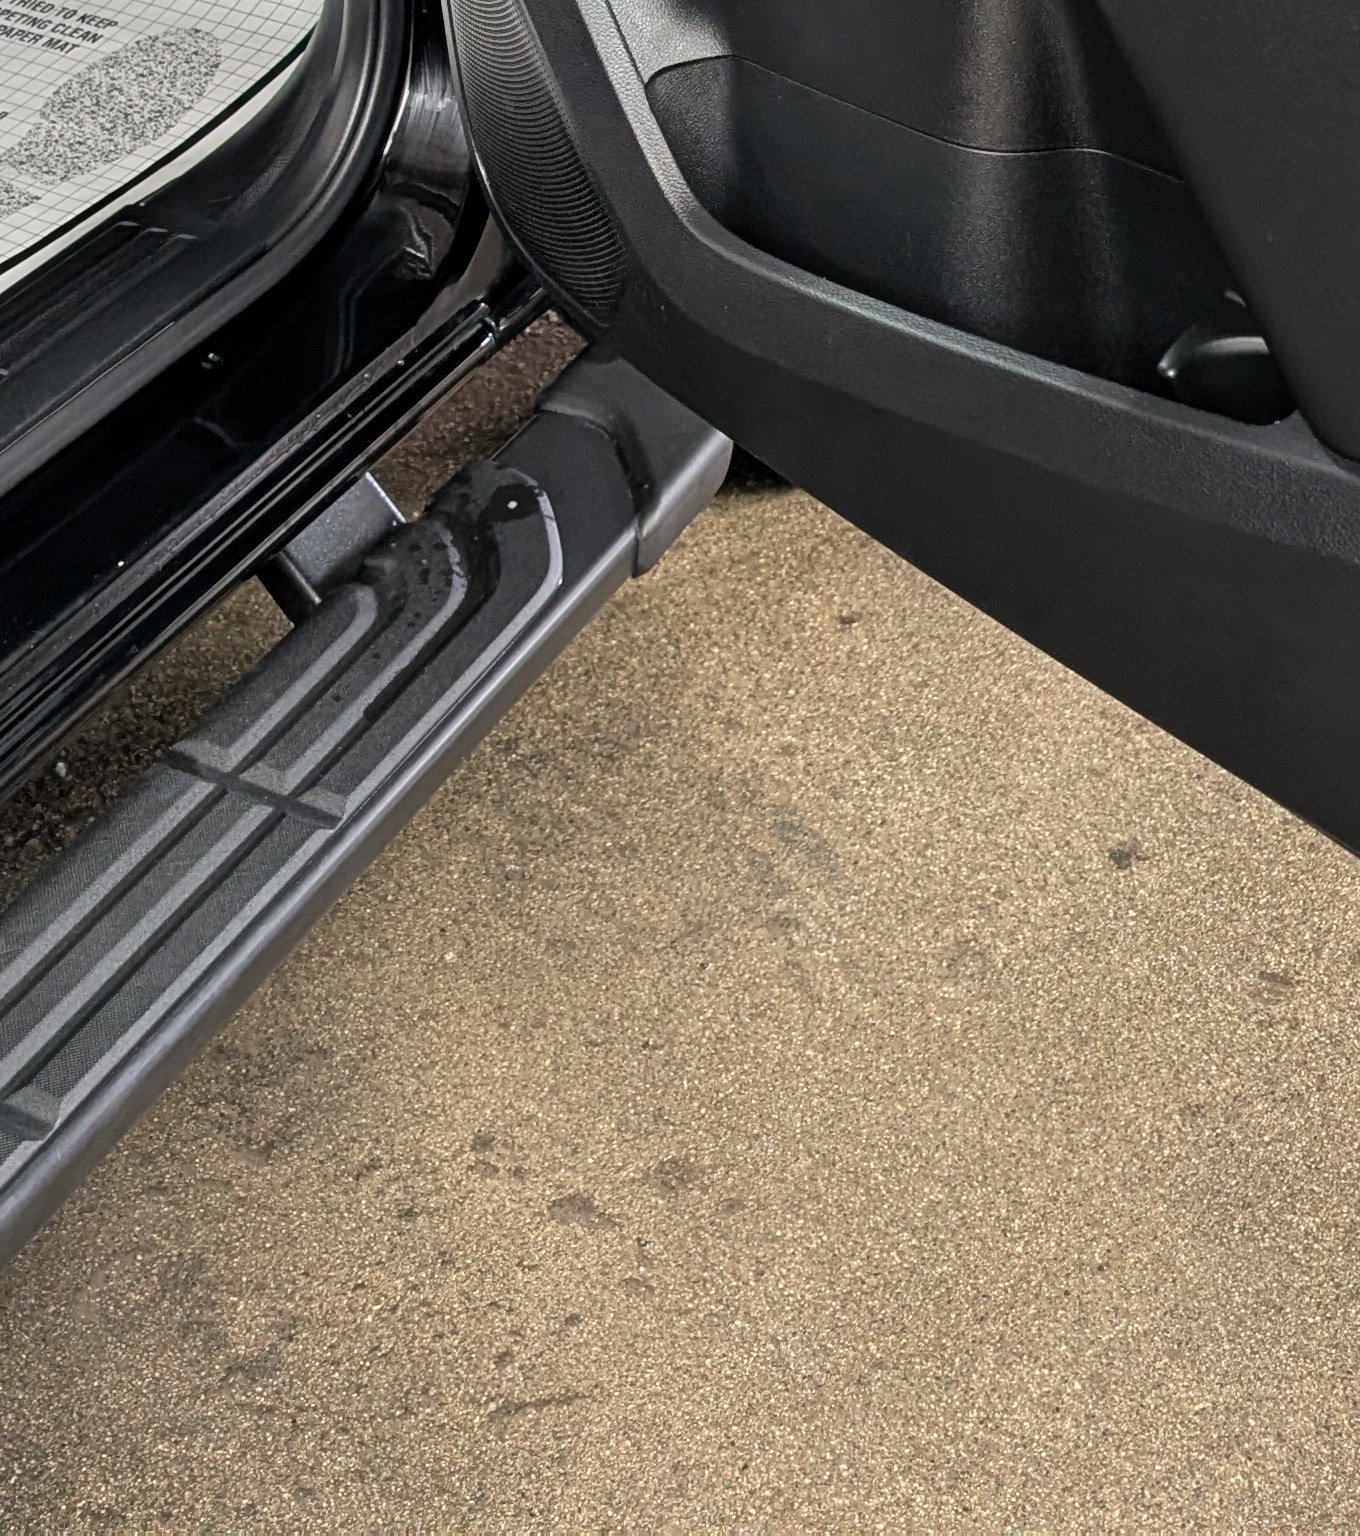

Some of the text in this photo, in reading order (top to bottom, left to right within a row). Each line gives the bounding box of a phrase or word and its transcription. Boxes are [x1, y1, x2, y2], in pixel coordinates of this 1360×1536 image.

[55, 5, 79, 21] TO
[76, 11, 118, 31] KEEP
[50, 22, 104, 44] CLEAN
[42, 36, 80, 55] MAT
